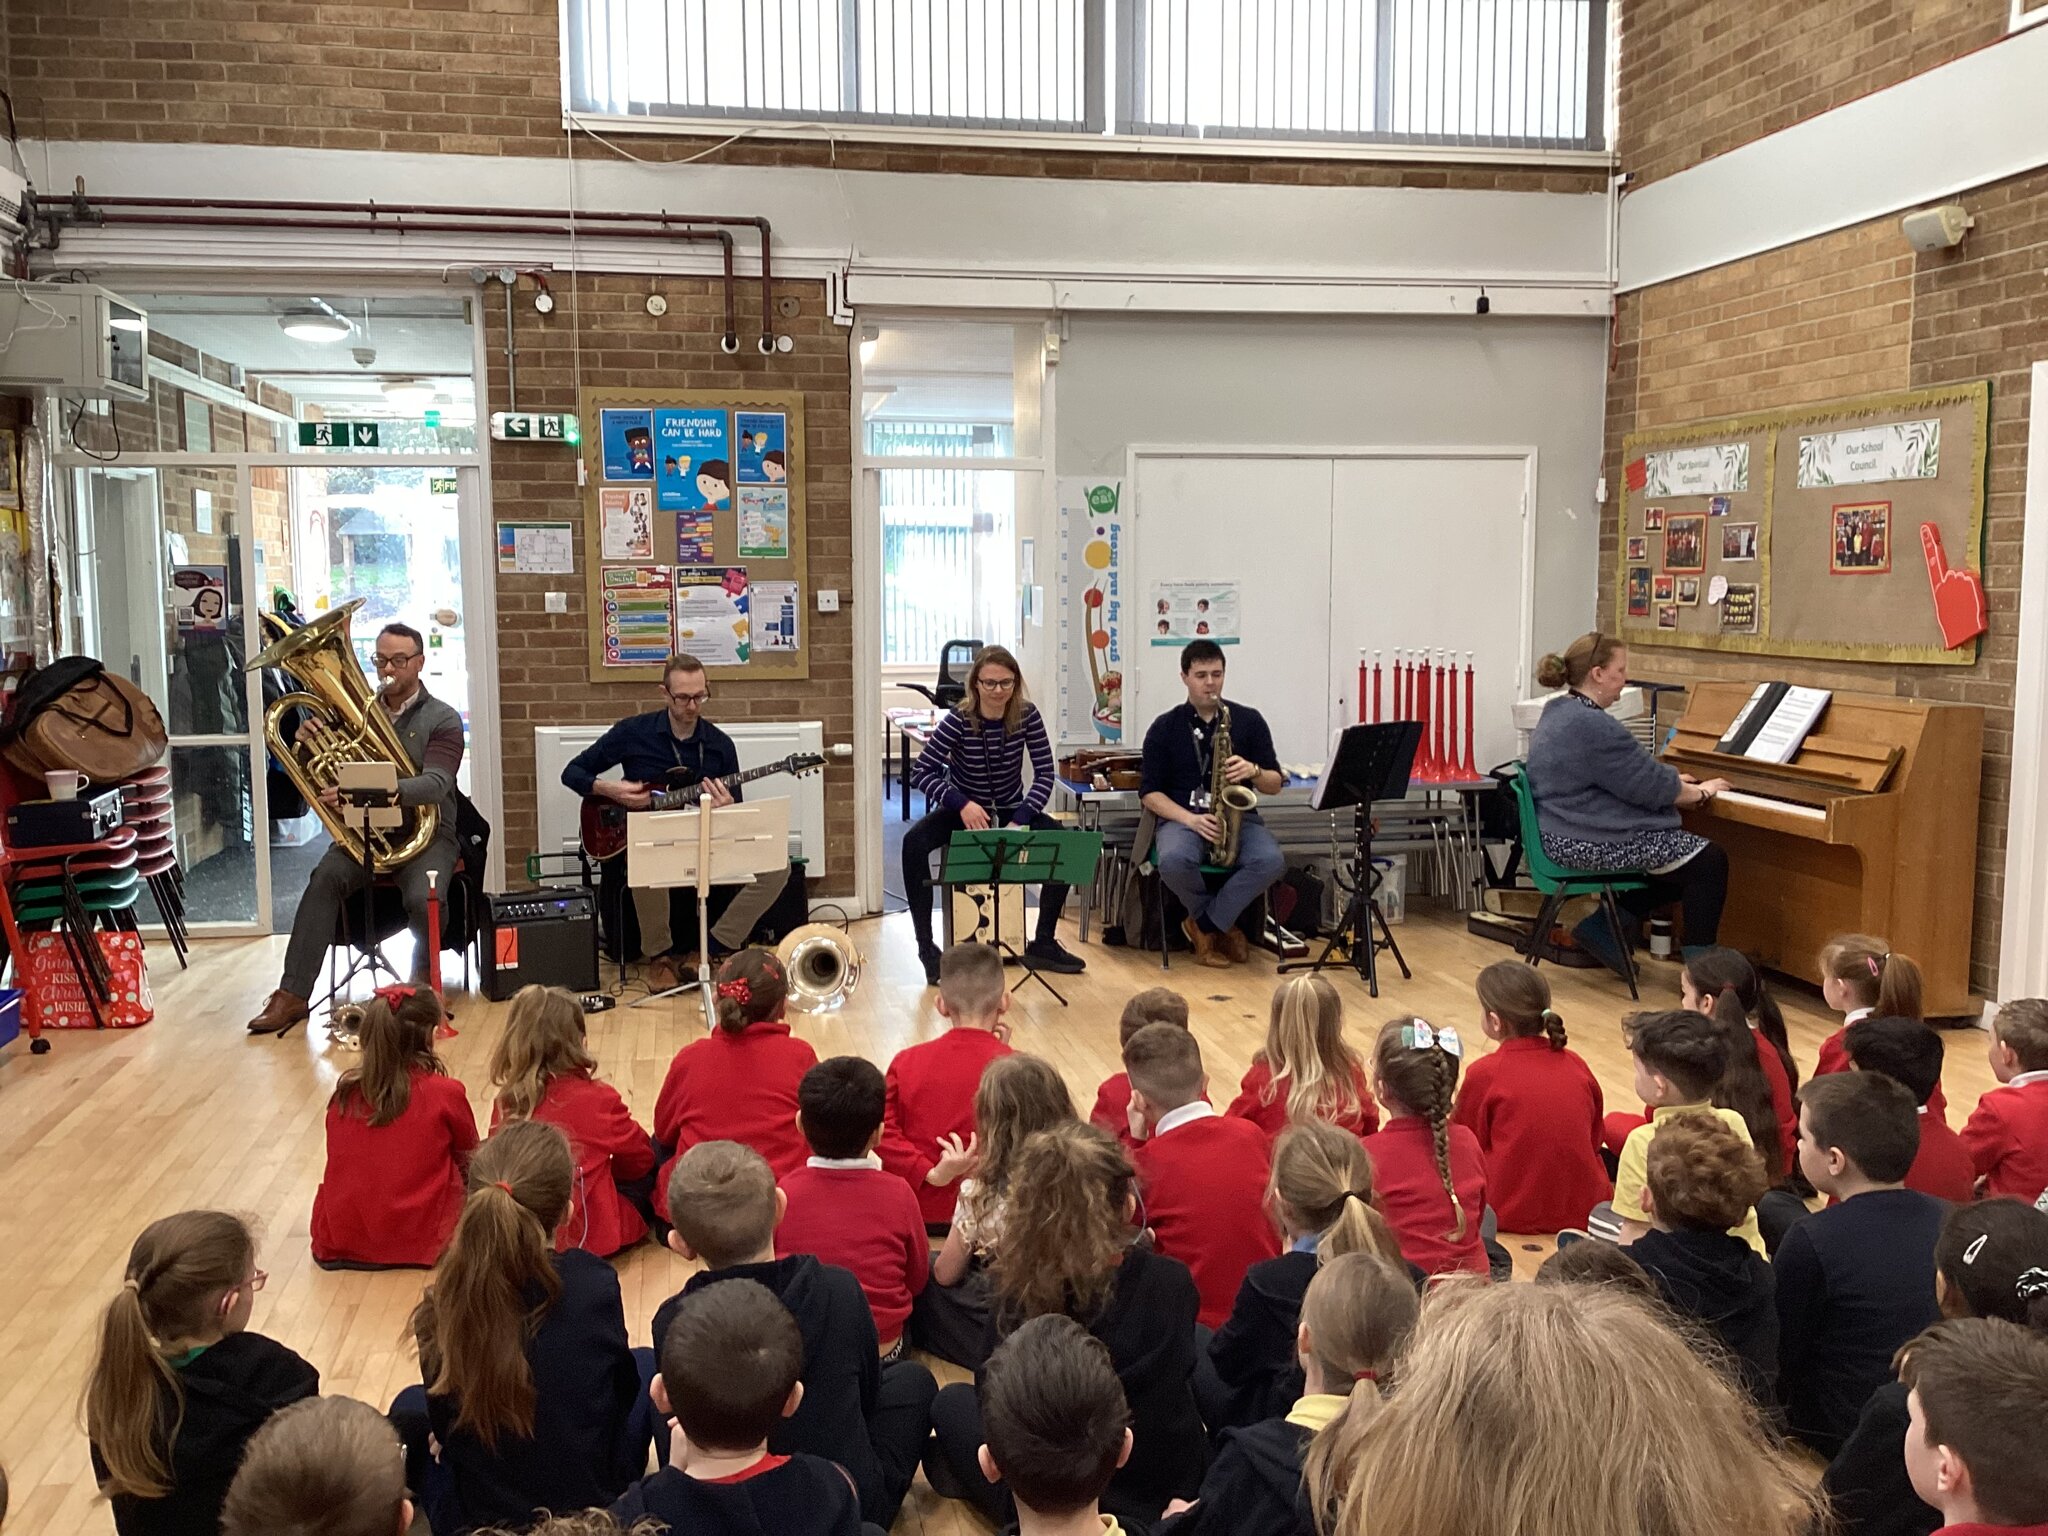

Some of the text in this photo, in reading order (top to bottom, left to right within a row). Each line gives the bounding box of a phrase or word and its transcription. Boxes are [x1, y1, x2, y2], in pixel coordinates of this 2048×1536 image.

[665, 418, 717, 427] FRIENDSHIP
[662, 428, 722, 437] CAN BE HARD
[1846, 440, 1884, 455] Our School
[1677, 462, 1687, 471] Our
[1091, 491, 1113, 505] eat
[1108, 523, 1121, 662] grow big and strong
[52, 972, 81, 984] KISS
